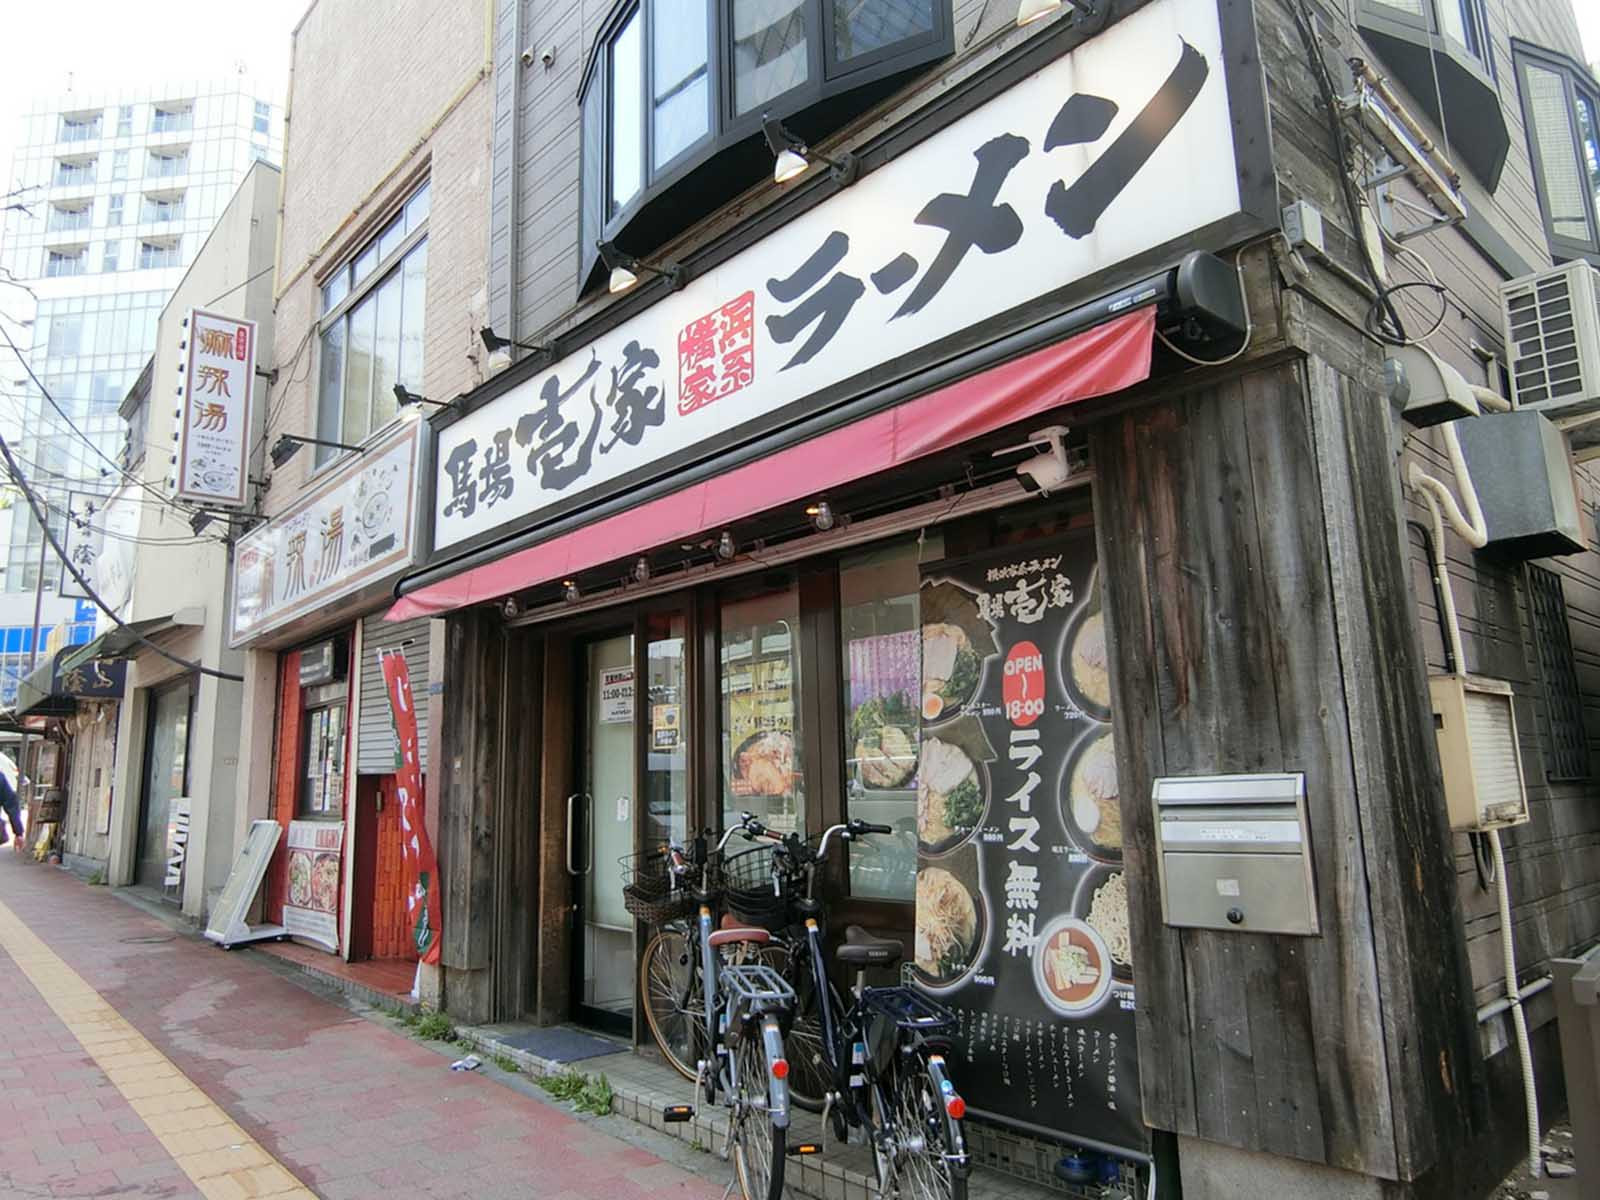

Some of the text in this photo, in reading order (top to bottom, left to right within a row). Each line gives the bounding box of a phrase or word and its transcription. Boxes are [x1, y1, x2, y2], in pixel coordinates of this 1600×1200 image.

[765, 34, 1210, 373] ラーメン
[443, 346, 667, 518] 馬場壱家
[1004, 653, 1043, 676] OPEN
[1005, 698, 1045, 720] 18:00
[1004, 729, 1043, 957] ライス無料
[1092, 1030, 1100, 1063] ラーメン
